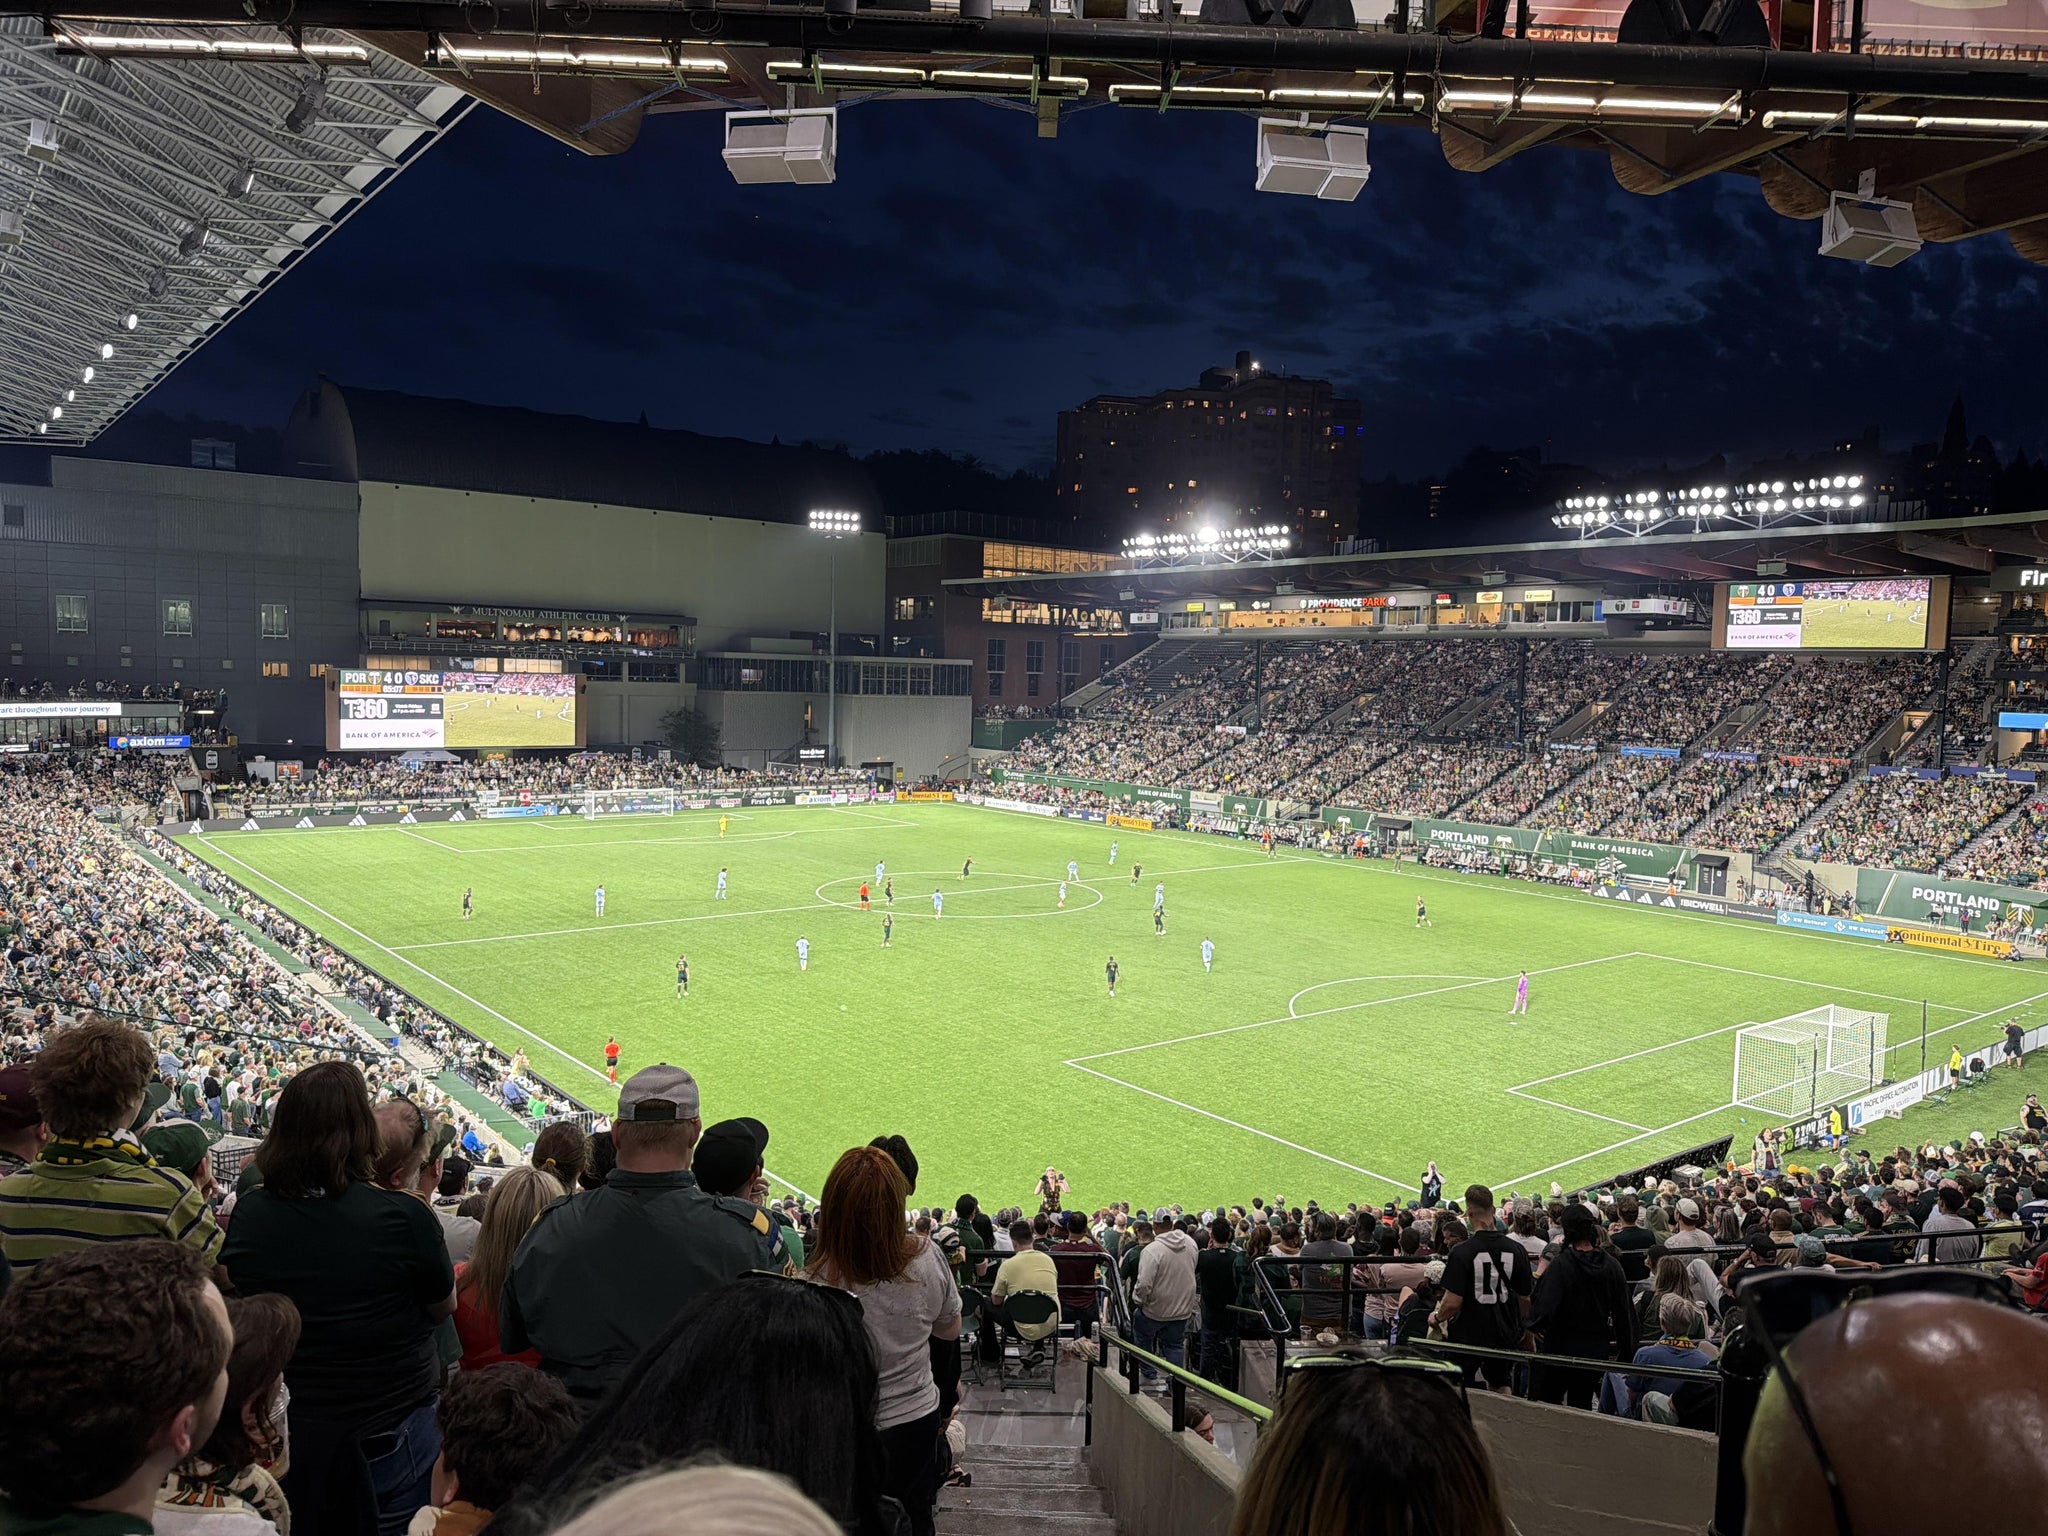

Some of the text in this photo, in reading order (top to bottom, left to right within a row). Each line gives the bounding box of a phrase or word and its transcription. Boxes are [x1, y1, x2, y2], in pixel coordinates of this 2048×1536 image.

[1757, 584, 1775, 595] 4 0
[472, 607, 610, 622] MULTNOMAH ATHLETIC CLUB
[345, 672, 440, 684] POR 4 0 SKC
[15, 705, 58, 714] throughout
[59, 706, 78, 714] your
[79, 705, 111, 714] journey
[343, 698, 388, 719] T360
[129, 736, 166, 747] axiom
[808, 795, 832, 803] axiom
[1137, 789, 1151, 797] BANK
[1159, 791, 1183, 800] AMERICA
[1431, 829, 1489, 845] PORTLAND
[1571, 840, 1654, 857] BANK OF AMERICA
[1912, 887, 2000, 911] PORTLAND
[1931, 902, 1982, 918] TMBRS
[1972, 940, 2001, 953] Tire
[1879, 1091, 1894, 1103] OFFICE
[1894, 1080, 1919, 1096] AUTOMATION
